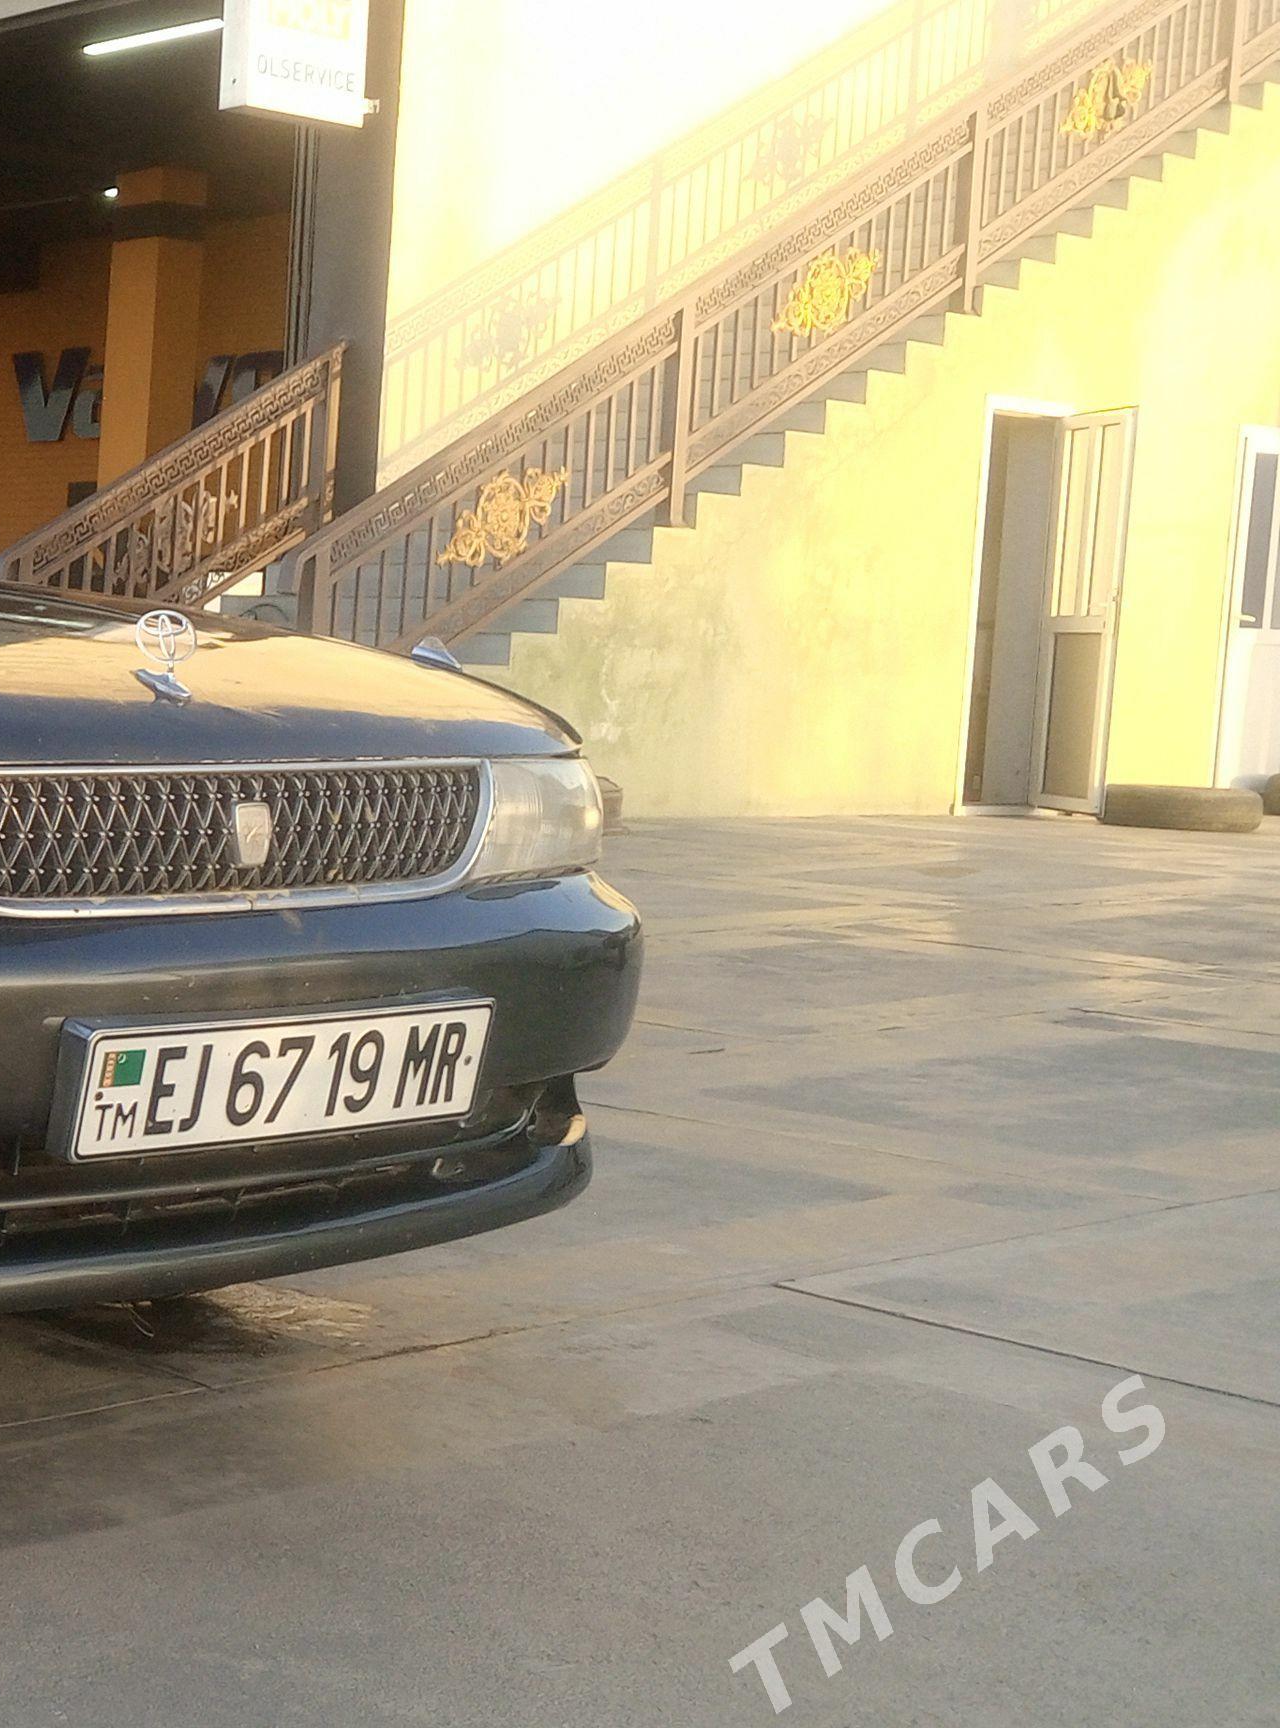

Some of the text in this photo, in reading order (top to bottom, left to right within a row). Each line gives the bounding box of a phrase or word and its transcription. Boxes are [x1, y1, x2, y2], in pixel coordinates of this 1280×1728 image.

[142, 1020, 469, 1136] EJ 67 19 MR
[94, 1100, 139, 1142] TM
